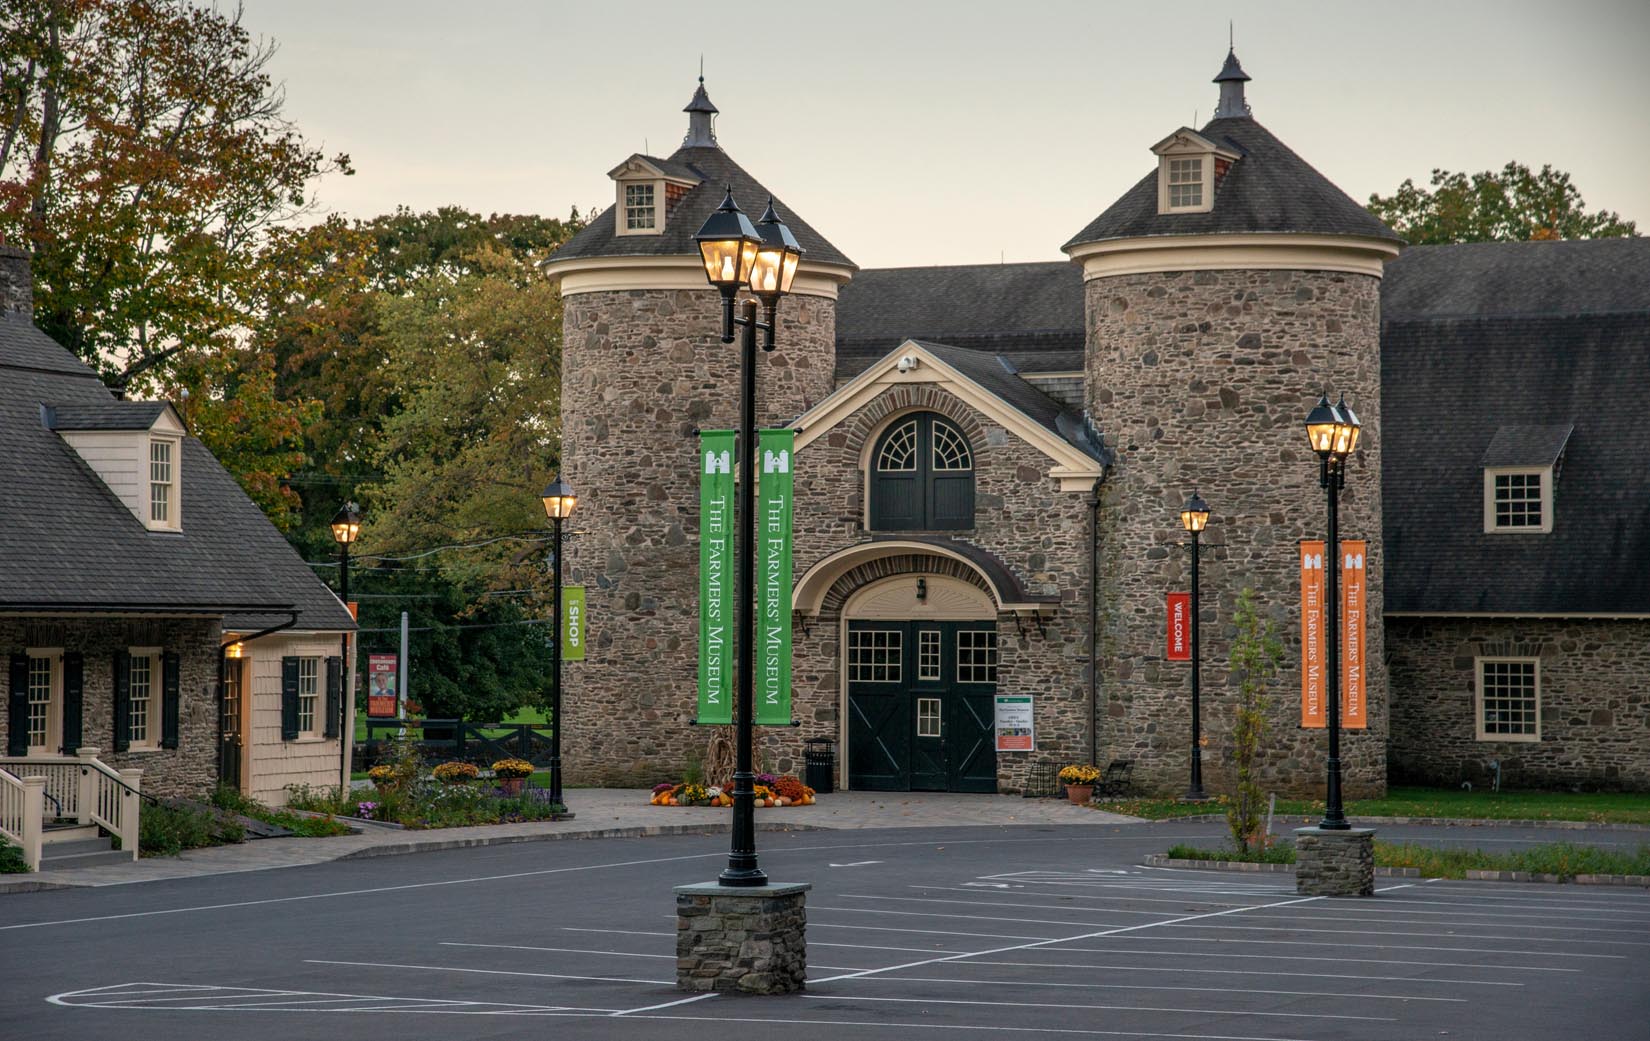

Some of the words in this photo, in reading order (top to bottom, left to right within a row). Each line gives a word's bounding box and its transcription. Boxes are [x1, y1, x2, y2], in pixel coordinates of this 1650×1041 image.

[710, 495, 725, 533] THE
[768, 494, 784, 533] THE
[708, 538, 725, 622] FARMERS'
[767, 538, 783, 622] FARMERS'
[1307, 582, 1319, 607] THE
[1348, 582, 1360, 607] THE
[569, 606, 580, 647] SHOP
[1174, 602, 1183, 653] WELCOME
[1307, 610, 1319, 663] FARMERS'
[1348, 610, 1360, 664] FARMERS'
[707, 625, 724, 705] MUSEUM
[766, 625, 782, 705] MUSEUM
[1308, 665, 1320, 716] MUSEUM
[1348, 665, 1360, 717] MUSEUM
